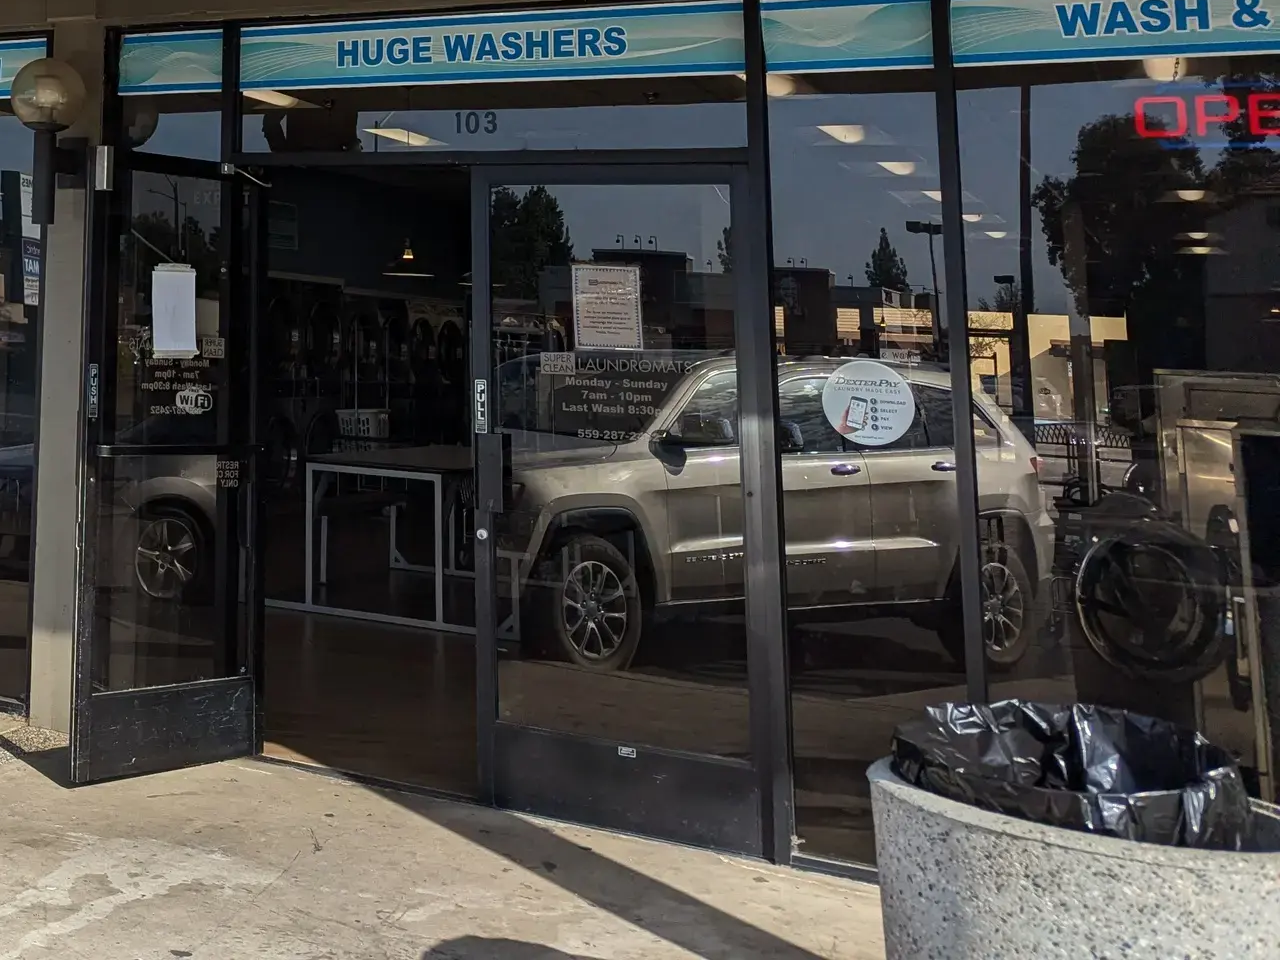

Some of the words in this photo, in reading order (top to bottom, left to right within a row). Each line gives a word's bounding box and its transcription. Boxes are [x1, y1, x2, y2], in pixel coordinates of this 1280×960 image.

[336, 36, 433, 69] HUGE
[443, 26, 629, 64] WASHERS
[454, 111, 499, 135] 103
[1133, 93, 1280, 139] OPE
[544, 354, 571, 363] SUPER
[578, 358, 692, 374] LAUNDROMATS
[543, 364, 574, 373] CLEAN
[565, 377, 612, 389] Monday
[622, 378, 668, 392] Sunday
[476, 384, 485, 420] PULL
[581, 390, 607, 400] 7am
[618, 391, 652, 404] 10pm
[562, 402, 589, 413] Last
[591, 403, 624, 415] Wash
[627, 404, 663, 417] 8:30p
